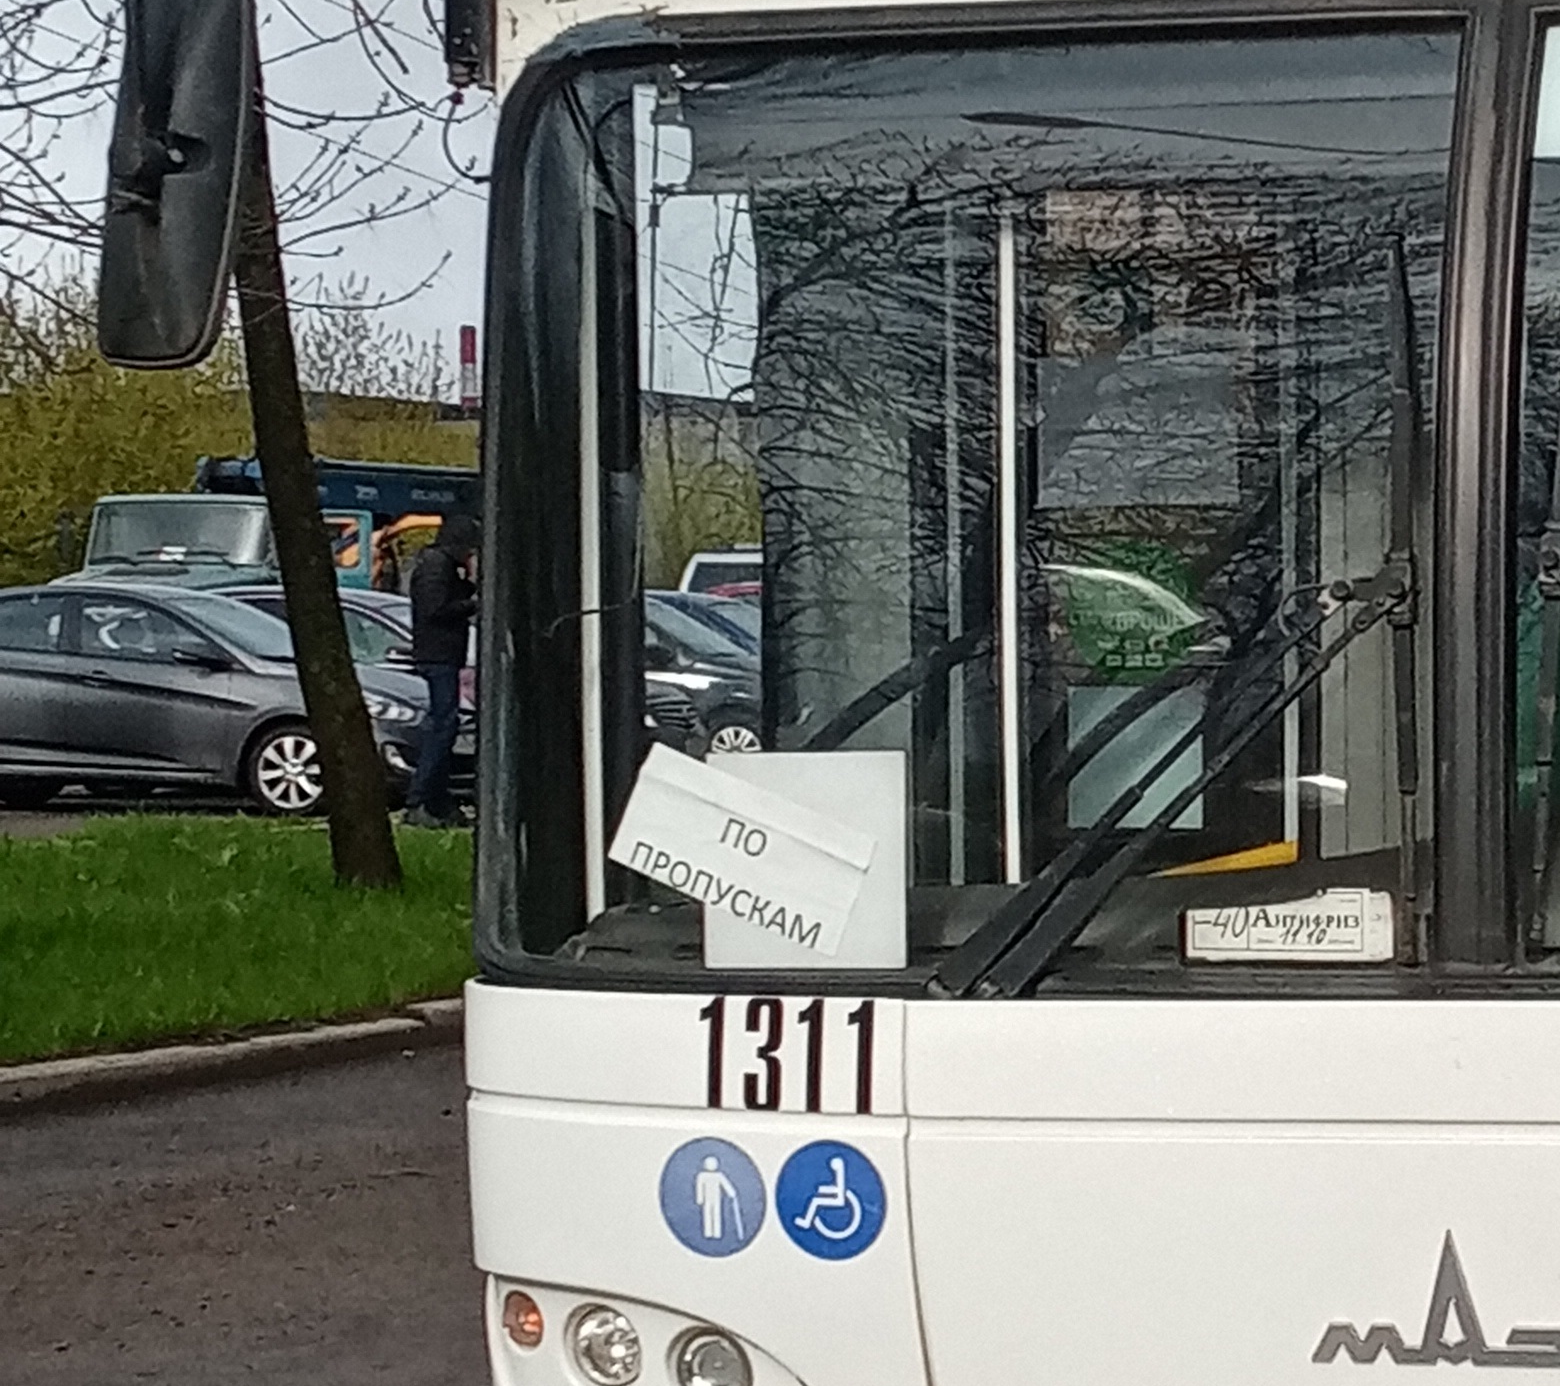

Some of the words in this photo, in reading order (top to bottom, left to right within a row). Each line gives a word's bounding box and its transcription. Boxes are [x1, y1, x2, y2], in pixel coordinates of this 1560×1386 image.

[718, 818, 768, 857] ПО
[628, 841, 822, 949] ПРОПУСКАМ
[699, 996, 874, 1114] 1311
